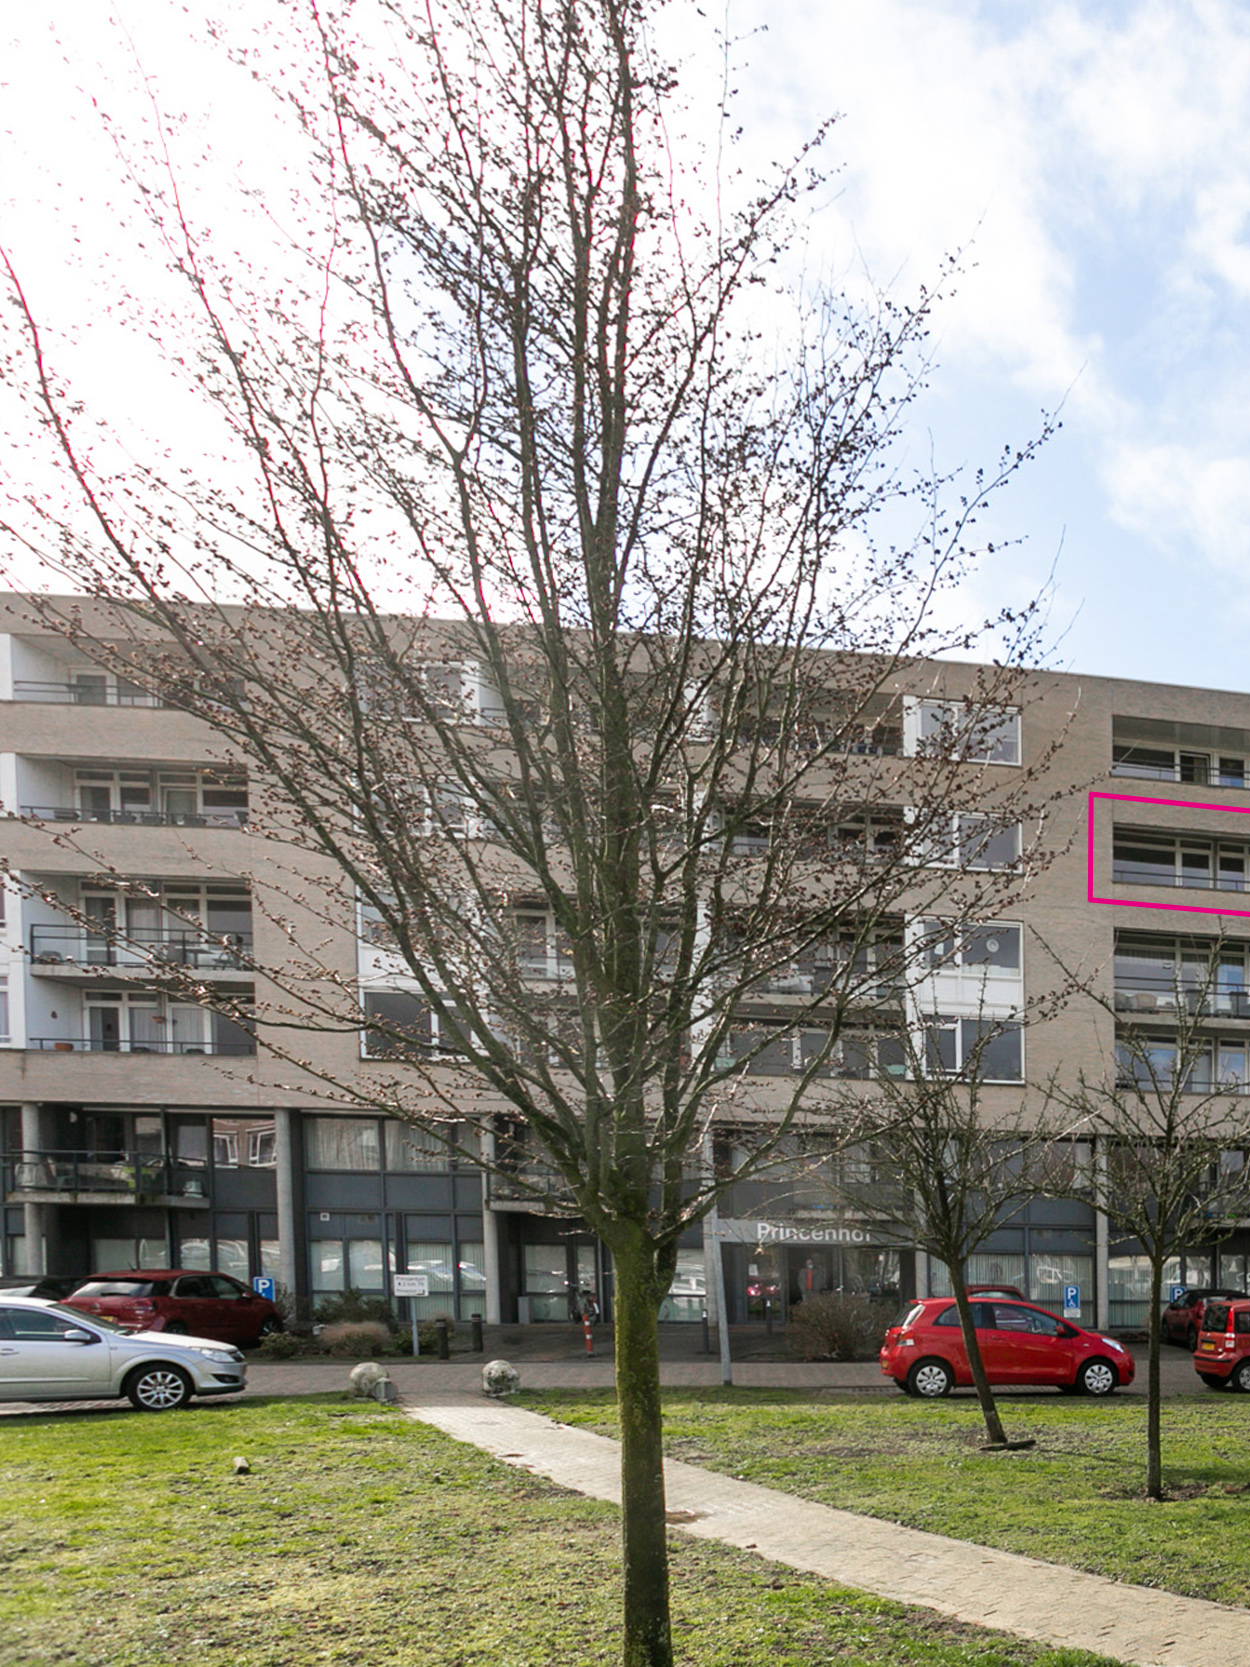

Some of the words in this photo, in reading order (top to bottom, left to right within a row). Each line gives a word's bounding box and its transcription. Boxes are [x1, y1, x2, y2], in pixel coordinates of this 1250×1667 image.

[258, 1279, 270, 1293] P
[1067, 1287, 1077, 1300] P
[1174, 1288, 1183, 1300] P
